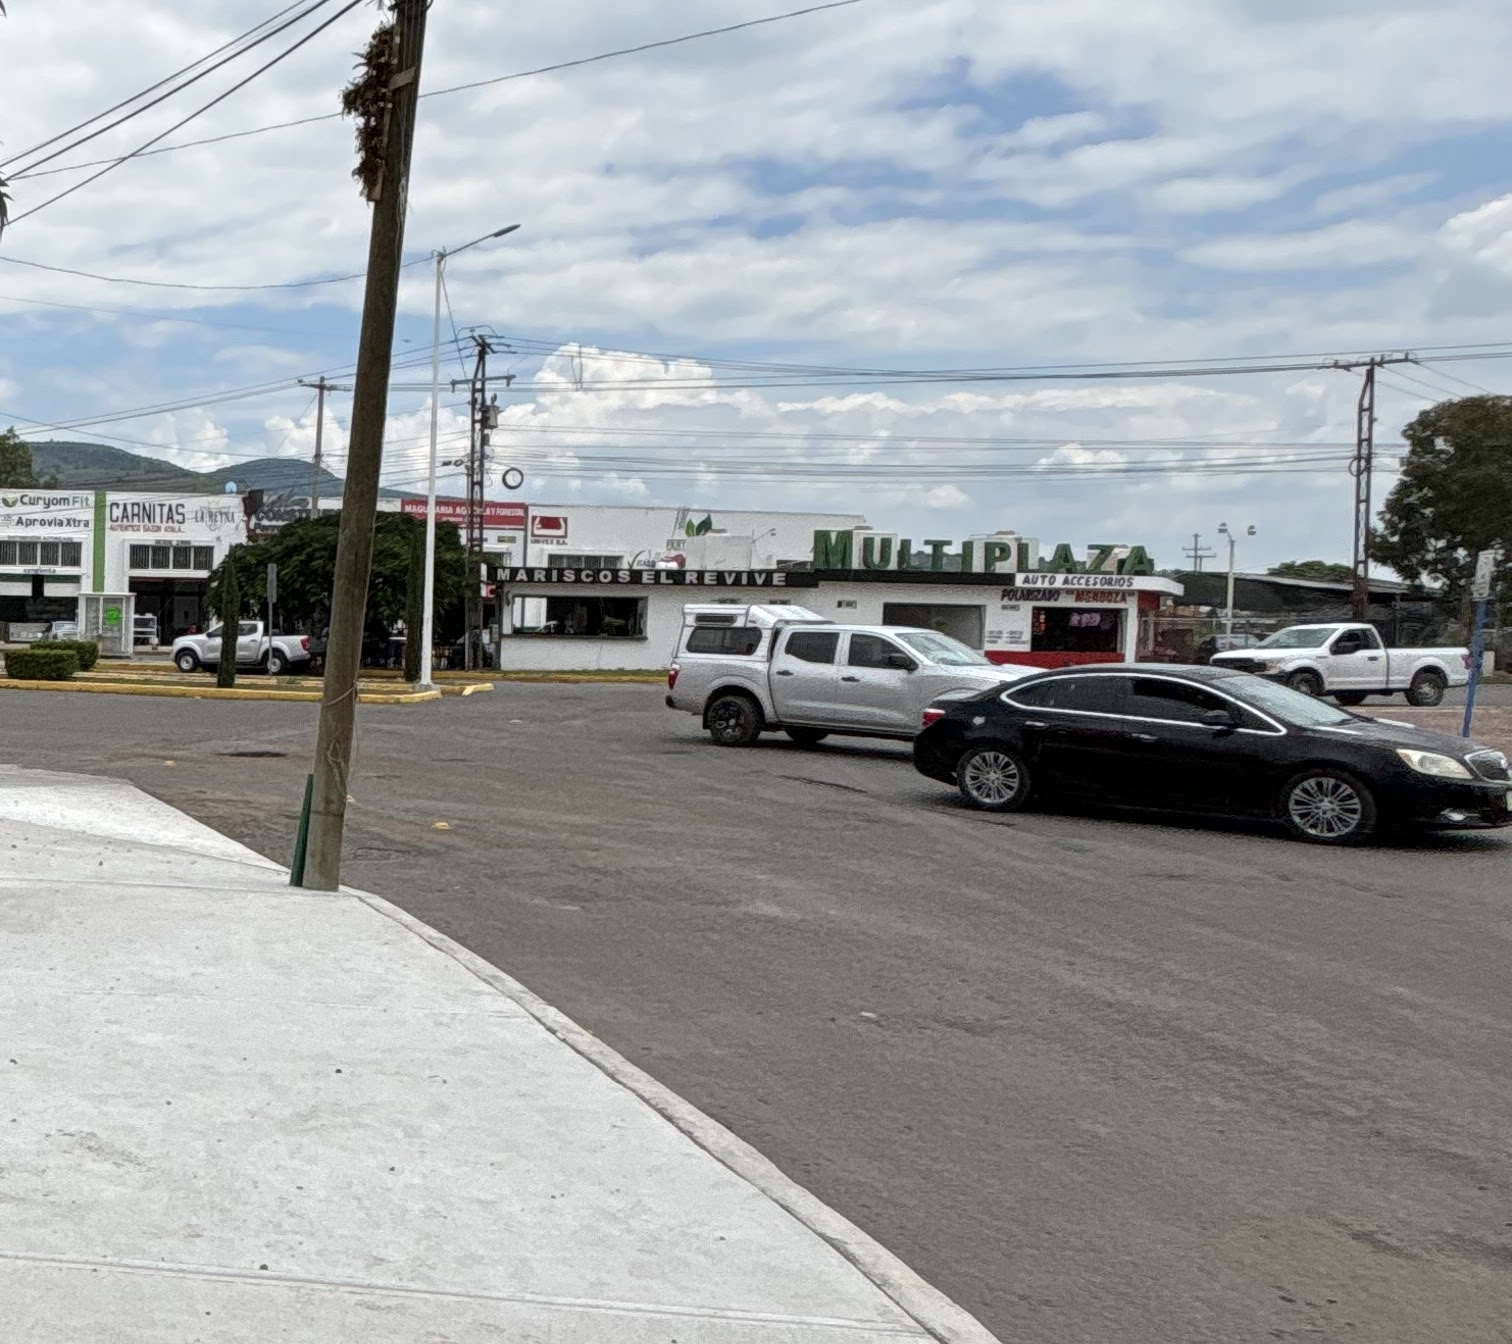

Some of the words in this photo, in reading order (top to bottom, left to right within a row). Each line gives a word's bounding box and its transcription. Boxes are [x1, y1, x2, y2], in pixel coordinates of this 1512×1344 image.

[20, 494, 70, 509] Curyom
[109, 502, 186, 524] CARNITAS
[813, 529, 1155, 576] MULTIPLAZA
[496, 568, 631, 584] MARISCOS
[641, 570, 674, 584] EL
[686, 570, 787, 586] REVIVE
[1021, 574, 1057, 586] AUTO
[1061, 575, 1135, 588] ACCESORIOS
